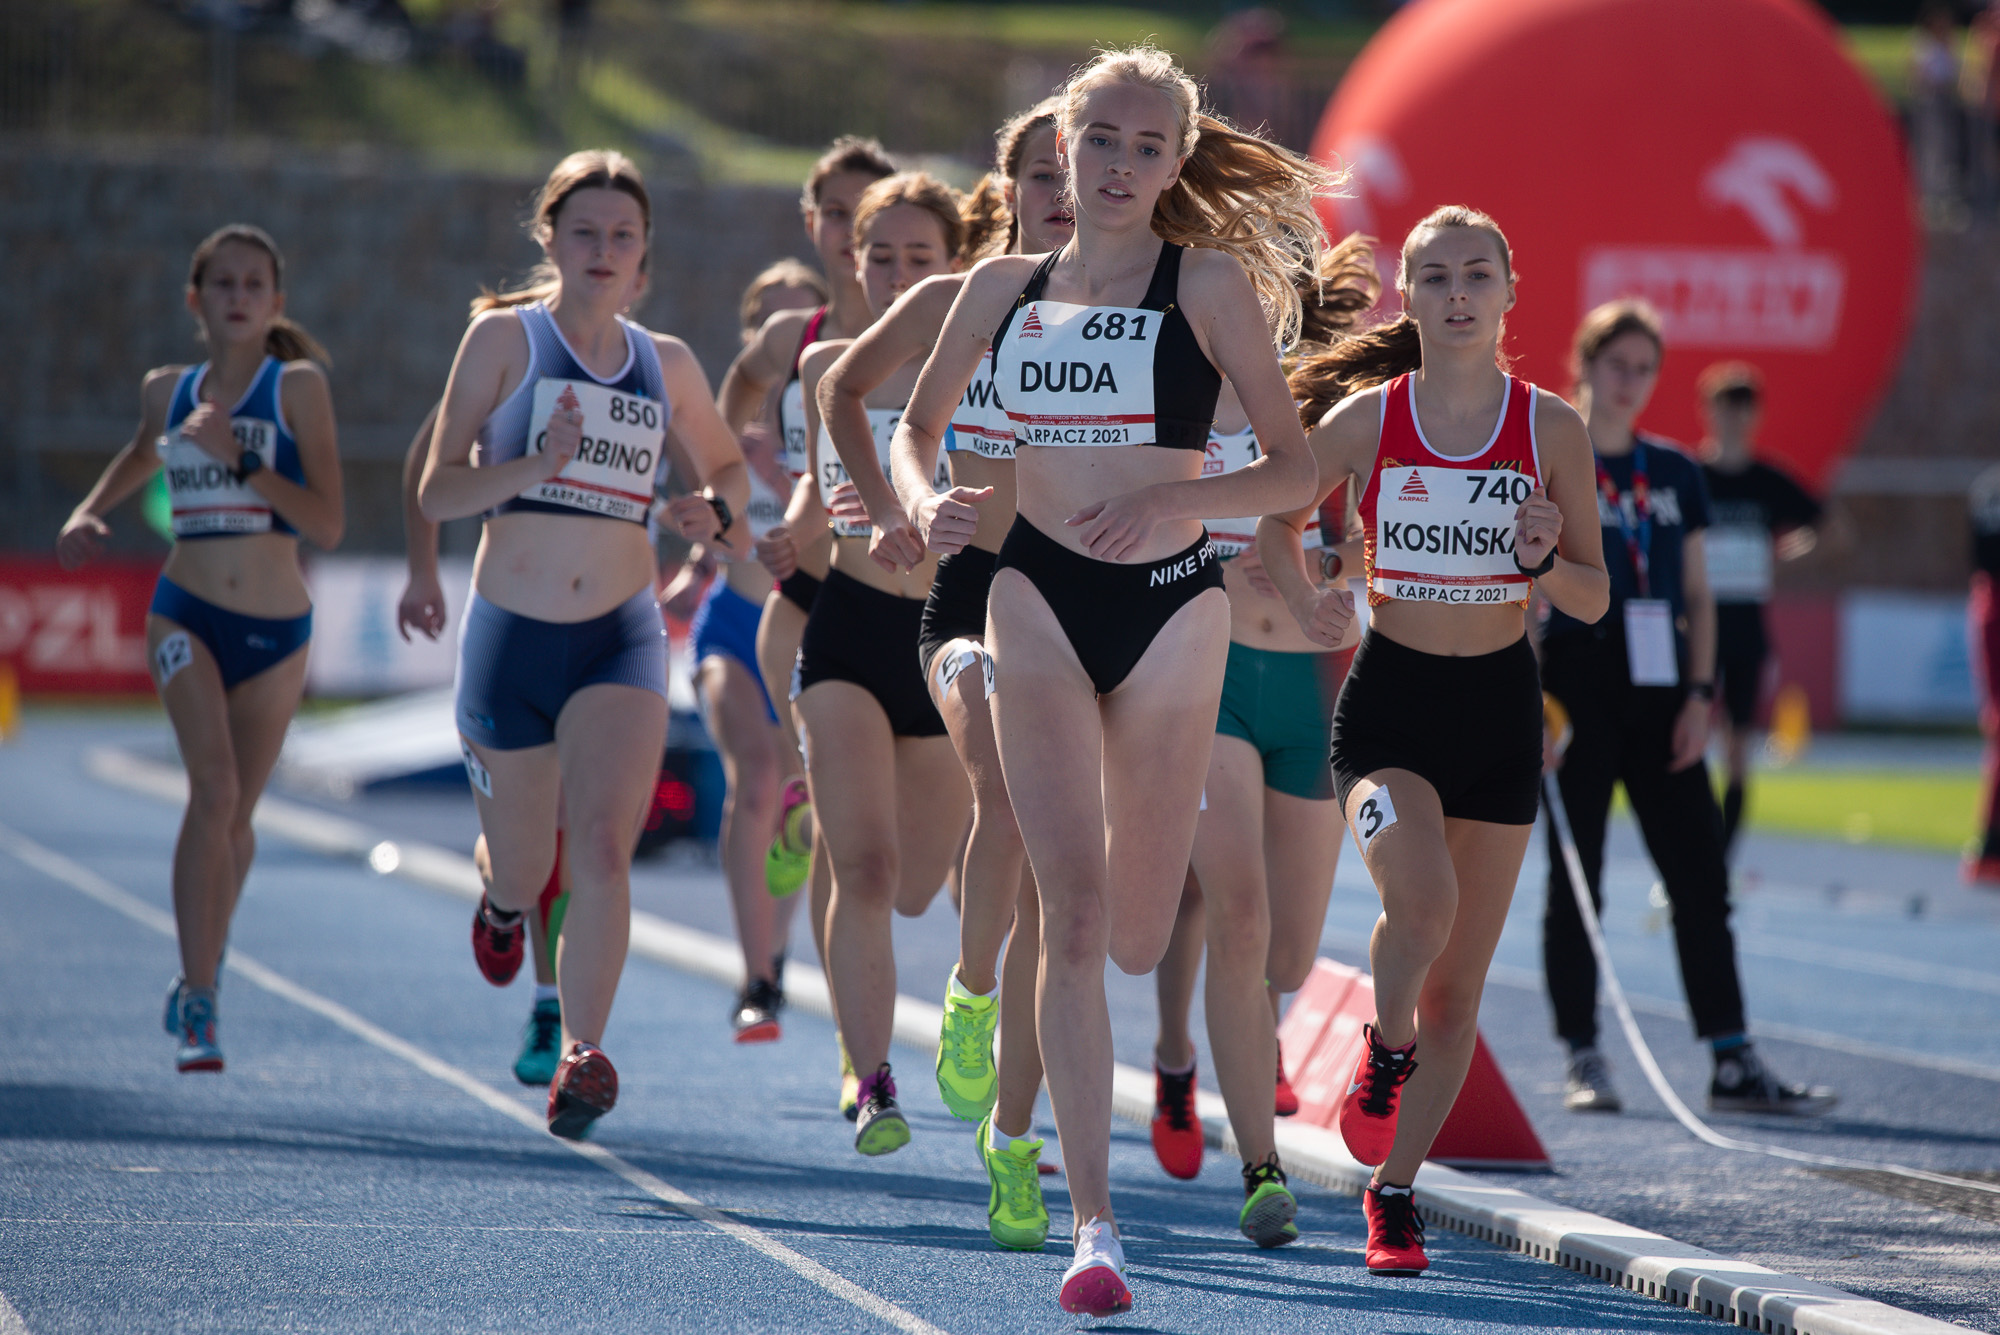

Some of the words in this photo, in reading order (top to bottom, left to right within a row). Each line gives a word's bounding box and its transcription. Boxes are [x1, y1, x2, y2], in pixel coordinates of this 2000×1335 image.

[1081, 312, 1147, 341] 681
[1020, 361, 1119, 394] DUDA
[610, 396, 657, 429] 850
[973, 437, 1016, 456] KARPA
[1026, 429, 1087, 444] ARPACZ
[1091, 428, 1129, 443] 2021
[536, 430, 653, 475] RBINO
[1466, 475, 1531, 505] 740
[1150, 555, 1197, 587] NIKE
[1396, 584, 1471, 602] KARPACZ
[1475, 588, 1508, 602] 2021
[942, 649, 962, 684] 5
[1360, 799, 1384, 839] 3
